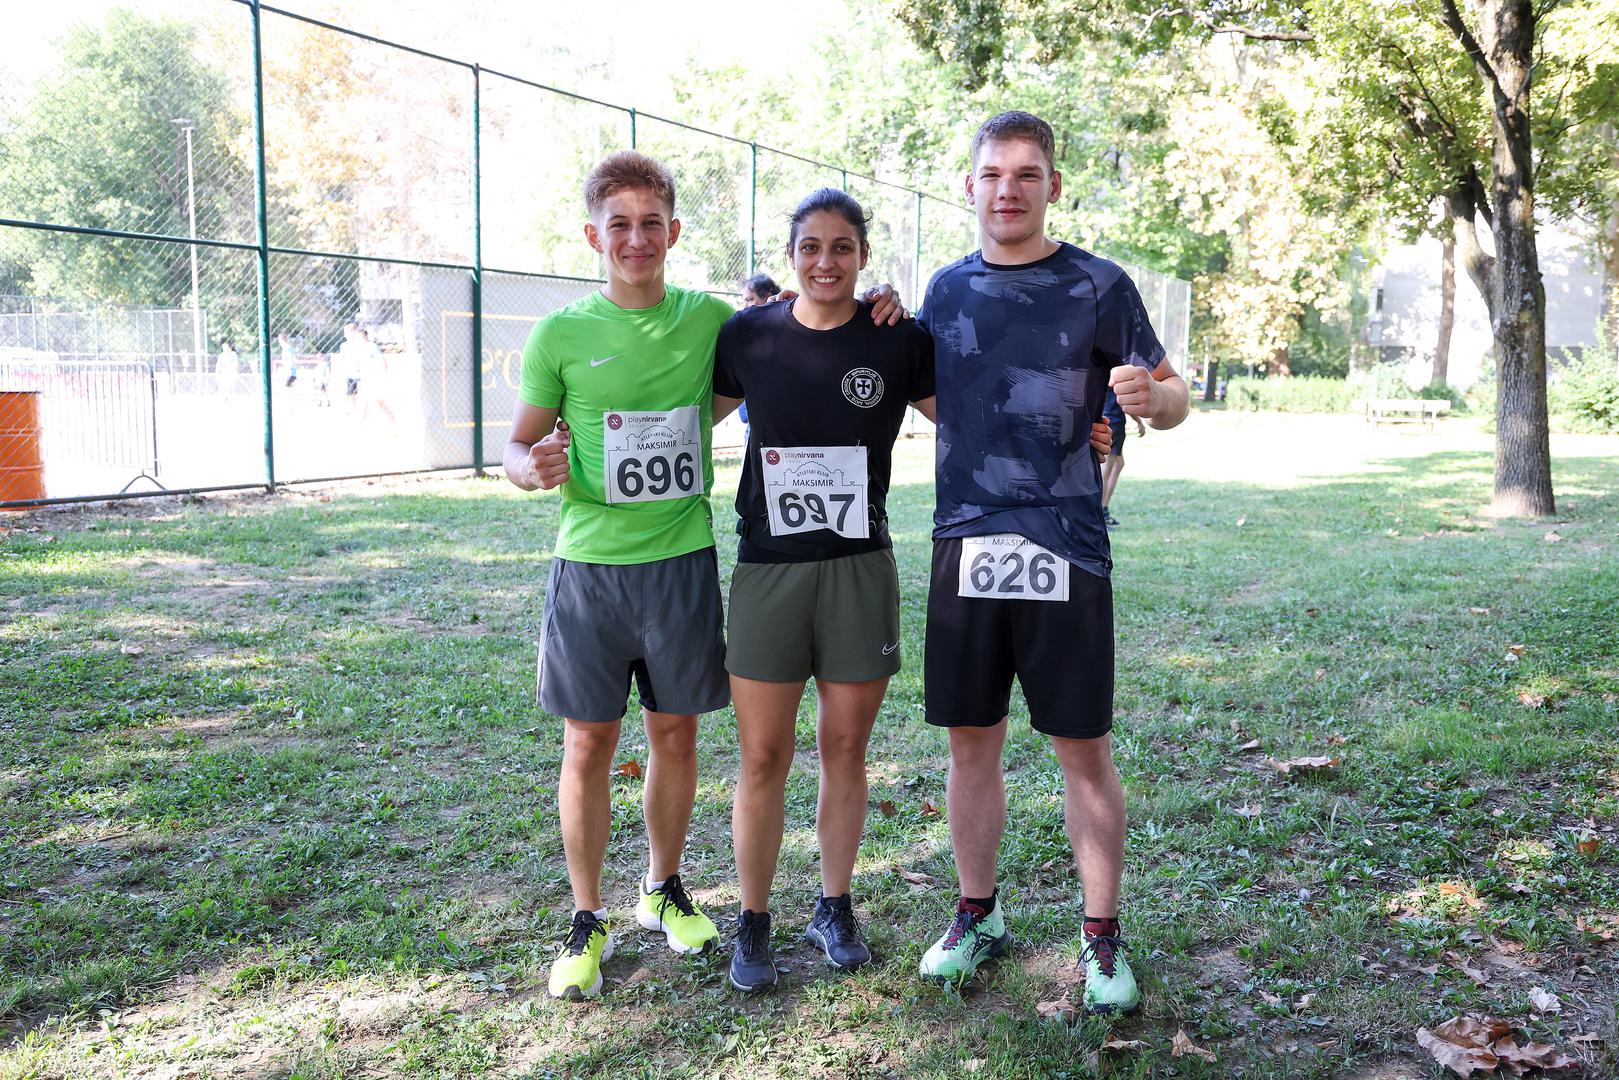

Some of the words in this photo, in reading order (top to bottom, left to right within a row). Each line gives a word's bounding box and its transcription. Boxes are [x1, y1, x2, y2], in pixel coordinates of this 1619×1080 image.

[637, 440, 677, 451] MAKSIMIR
[784, 451, 825, 460] playnirvana
[617, 452, 694, 497] 696
[792, 479, 834, 487] MAKSIMIR
[778, 492, 855, 532] 697
[970, 551, 1057, 595] 626
